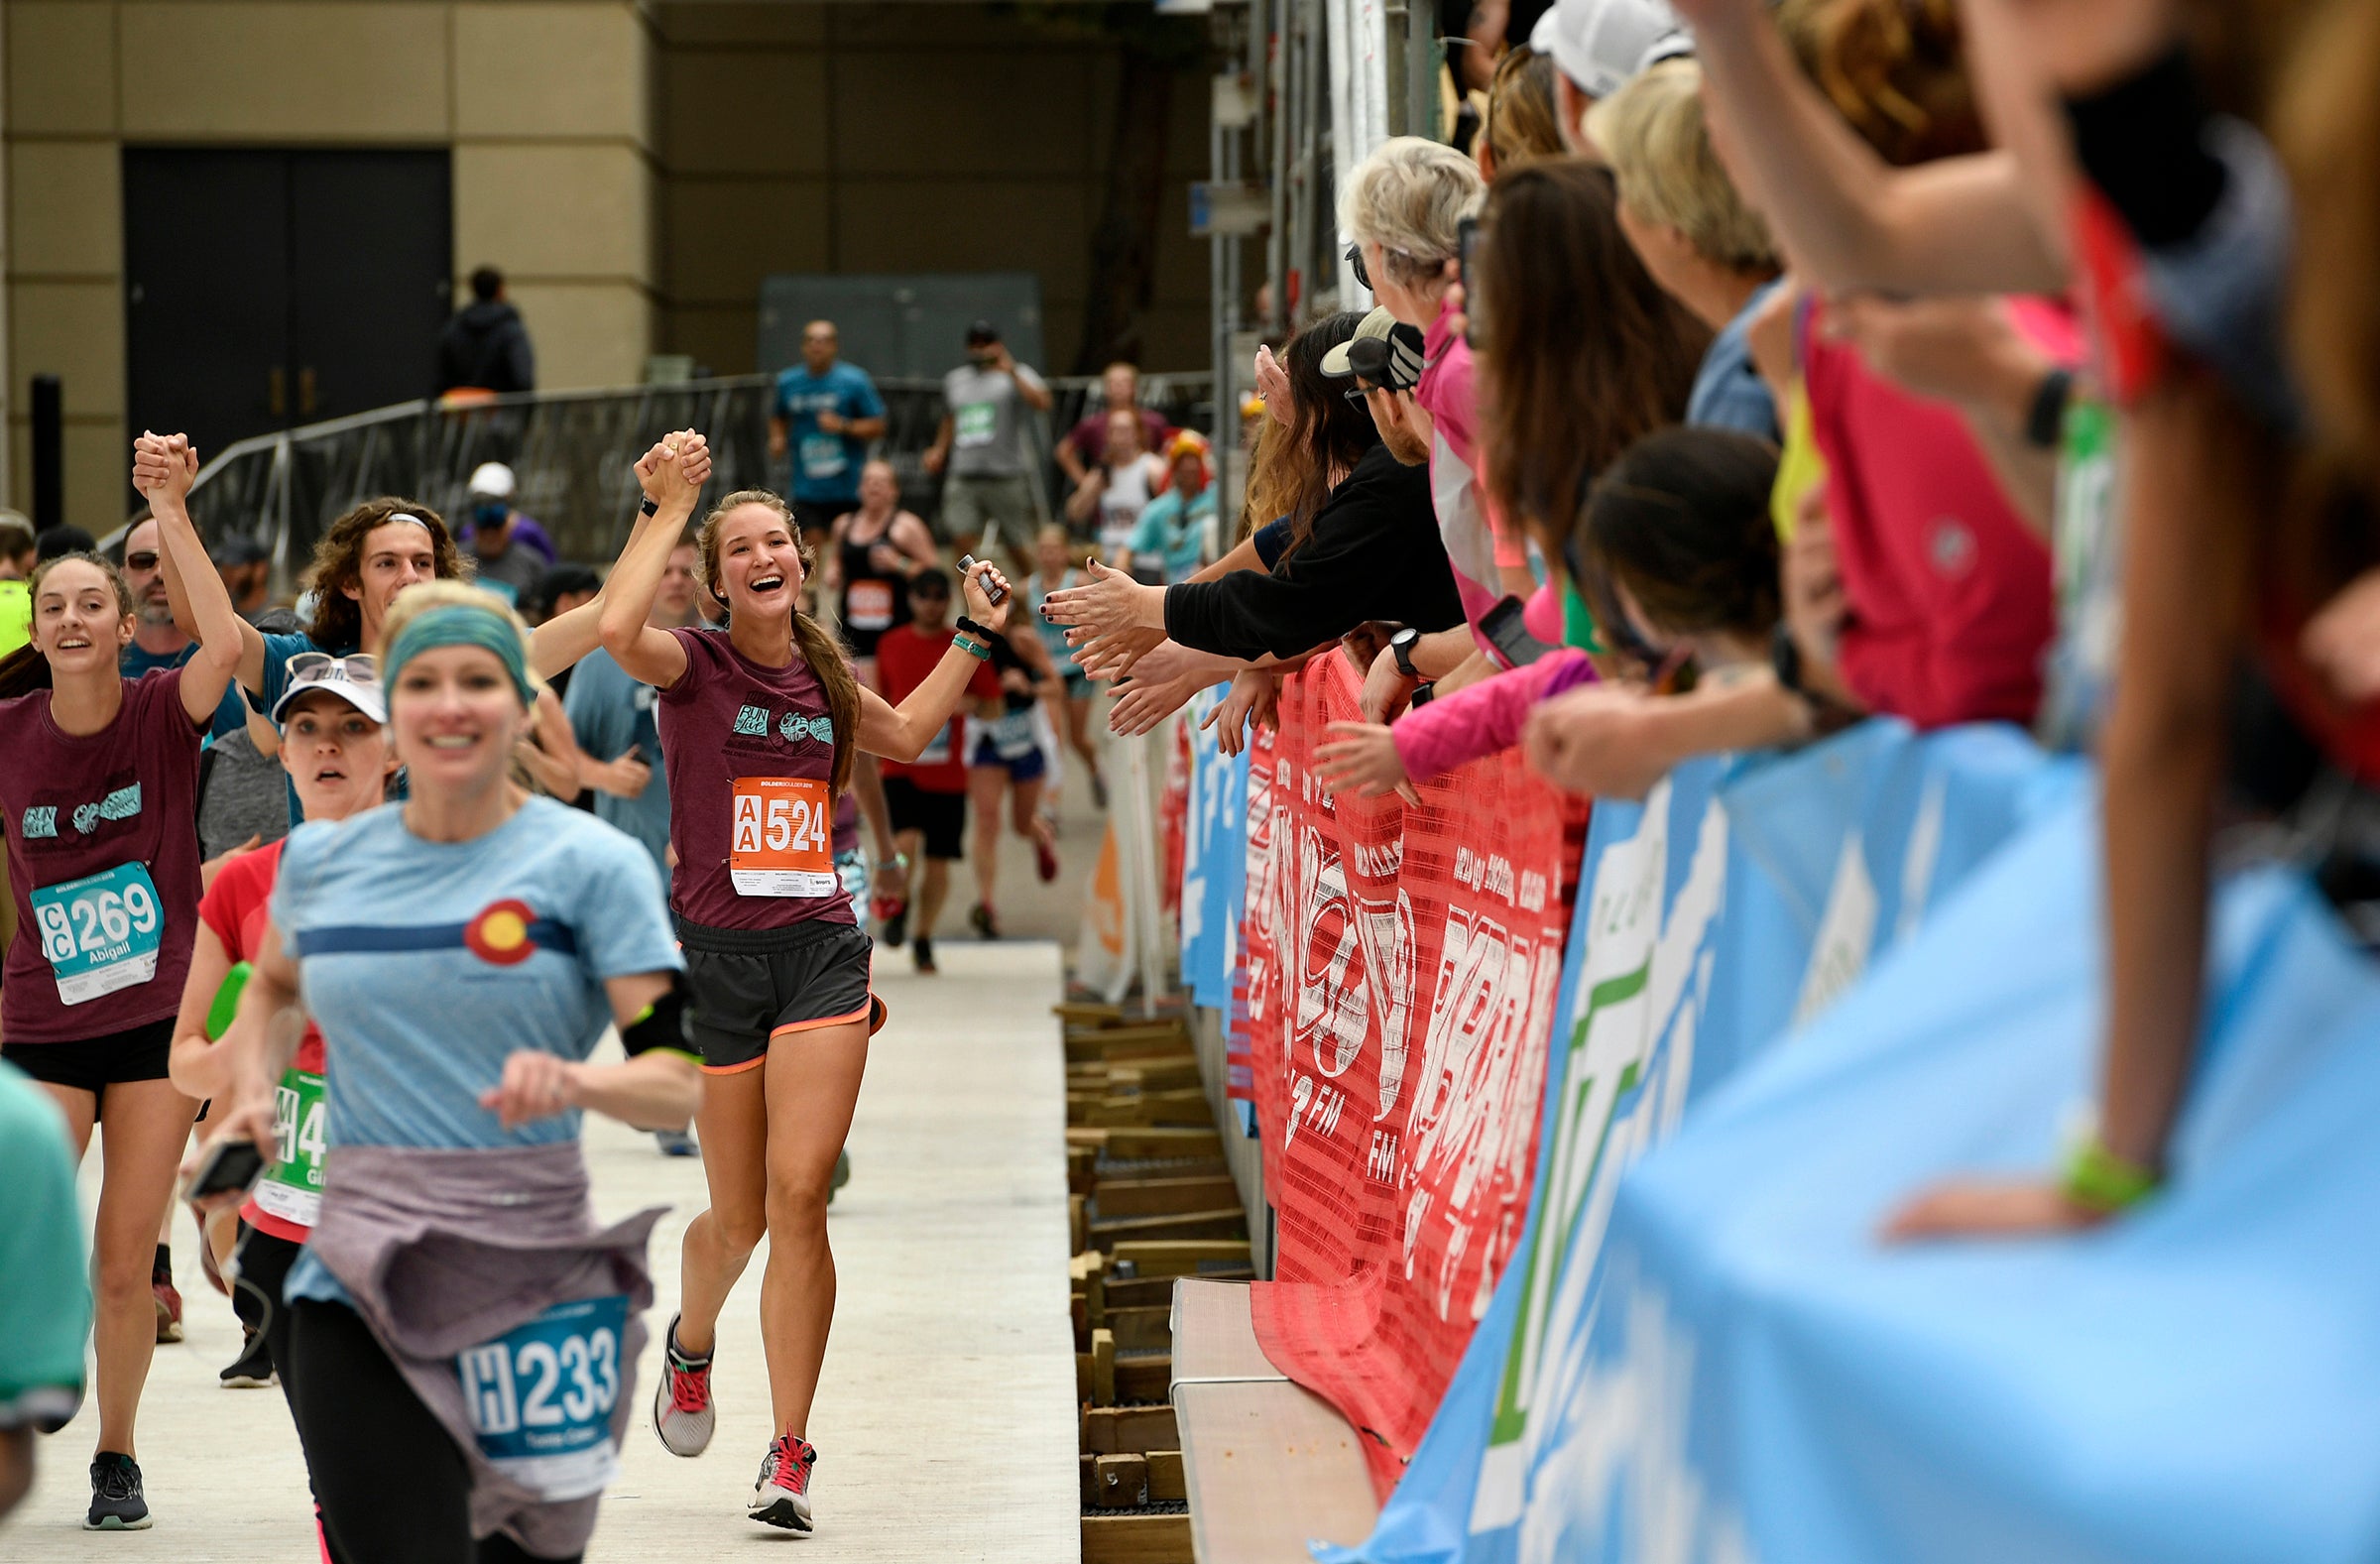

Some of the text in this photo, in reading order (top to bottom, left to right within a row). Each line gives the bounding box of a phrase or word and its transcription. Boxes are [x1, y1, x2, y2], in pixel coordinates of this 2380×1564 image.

[739, 706, 768, 722] RUN
[766, 798, 826, 853] 524
[70, 883, 157, 952] 269
[89, 940, 131, 964] Abigail
[1306, 1084, 1346, 1138] FM
[1368, 1130, 1397, 1183] FM
[516, 1326, 620, 1426] 233
